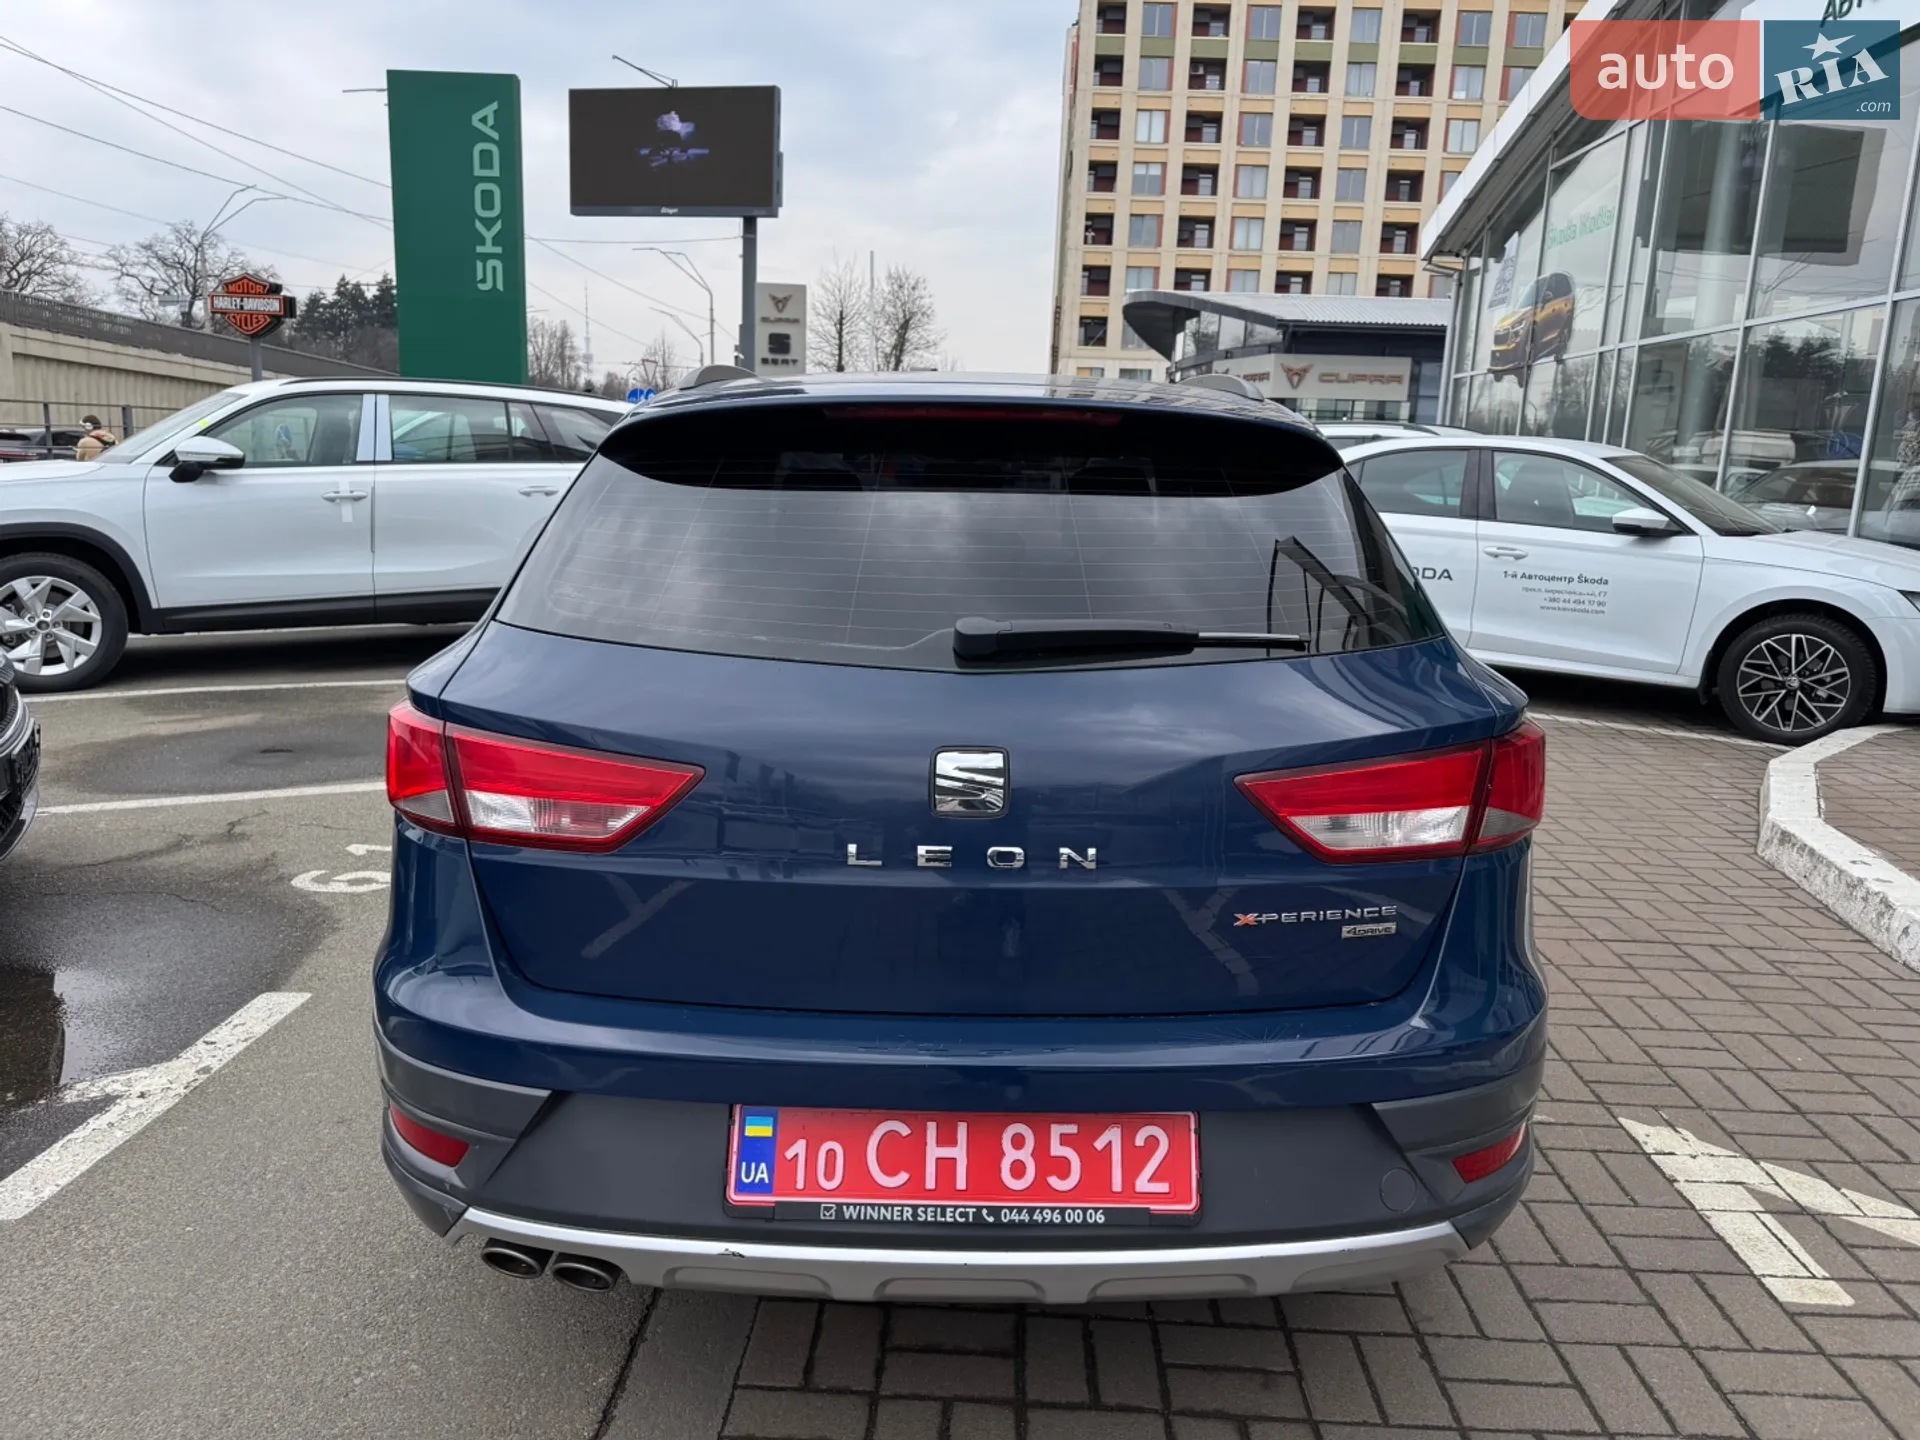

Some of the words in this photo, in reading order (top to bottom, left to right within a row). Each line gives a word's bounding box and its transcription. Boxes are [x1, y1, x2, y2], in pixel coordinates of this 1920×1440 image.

[228, 279, 264, 294] MOTOR
[213, 295, 280, 311] HARLEY-DAVIDSON
[229, 314, 265, 330] CYCLES
[1318, 373, 1404, 385] CUPRA
[1503, 570, 1518, 579] 1-й
[1520, 572, 1574, 585] Автоцентр
[1577, 573, 1609, 585] Škoda
[847, 843, 1097, 870] LEON
[1346, 925, 1394, 937] 4DRIVE
[784, 1138, 844, 1191] 10
[866, 1120, 969, 1191] CH
[1000, 1122, 1171, 1195] 8512
[740, 1161, 769, 1184] UA
[842, 1205, 914, 1221] WINNER
[917, 1207, 977, 1223] SELECT
[1001, 1209, 1030, 1223] 044
[1033, 1210, 1061, 1224] 496
[1065, 1210, 1083, 1224] 00
[1086, 1210, 1105, 1224] 06
